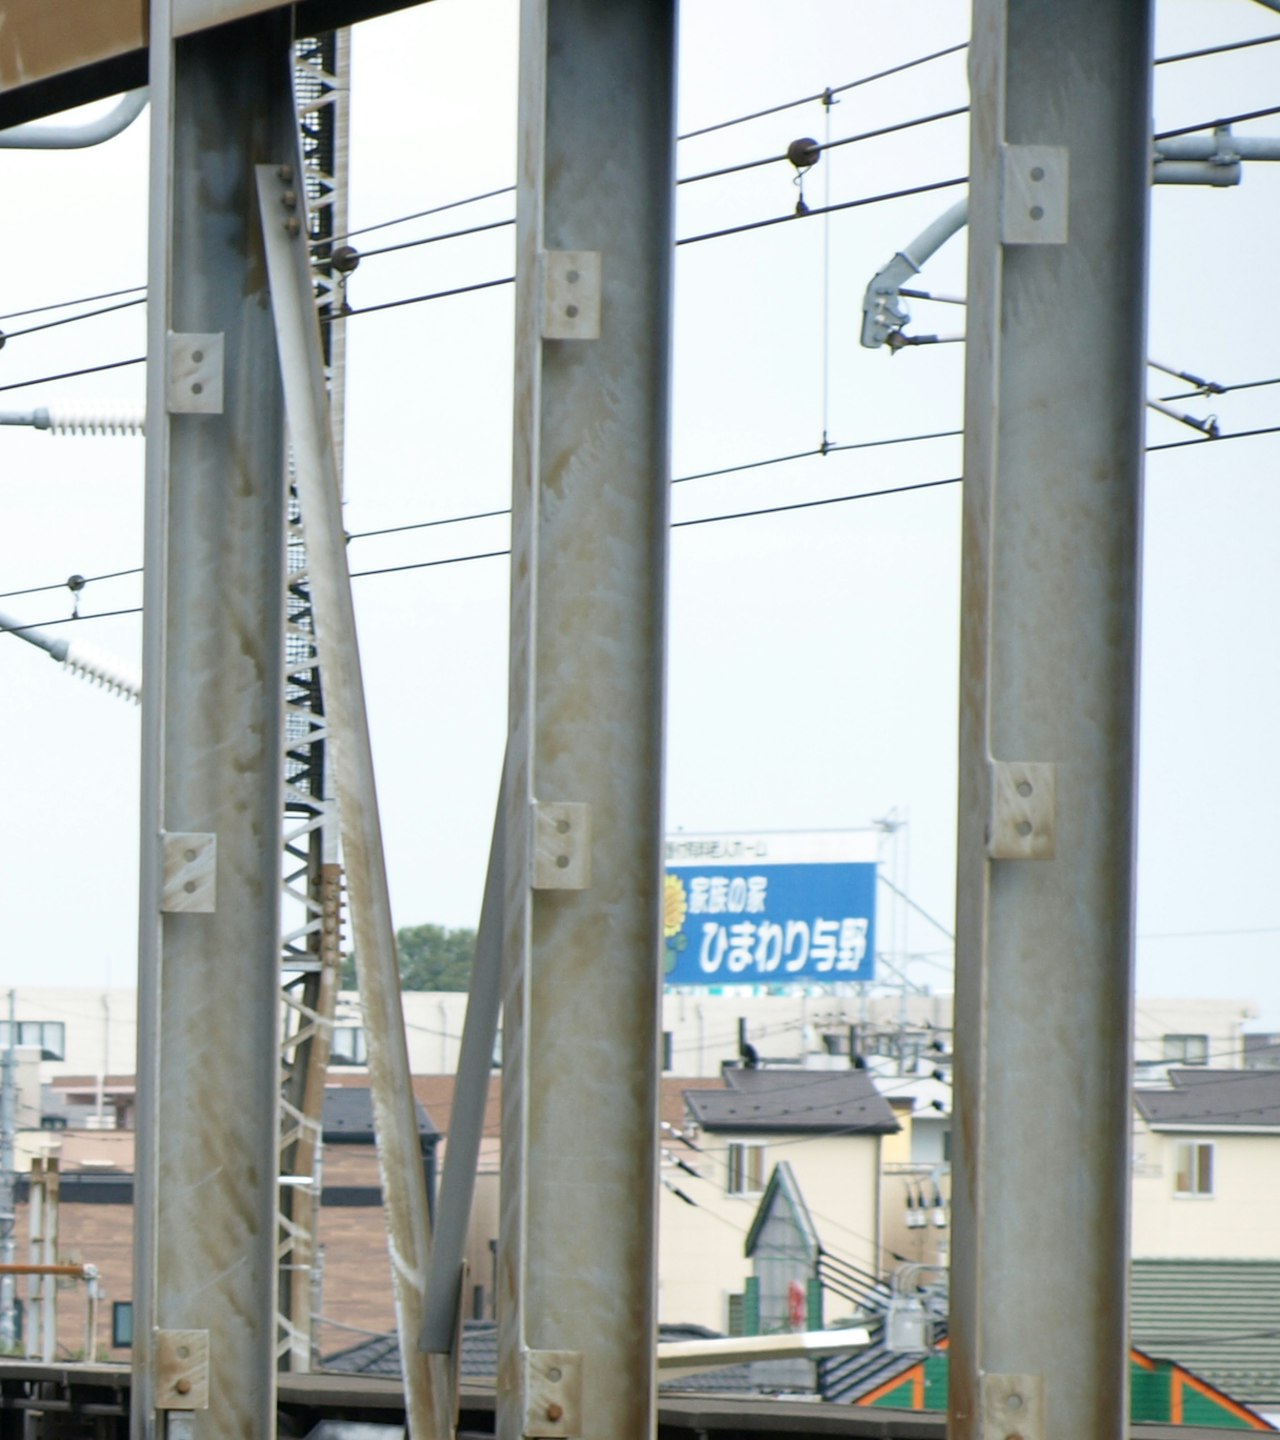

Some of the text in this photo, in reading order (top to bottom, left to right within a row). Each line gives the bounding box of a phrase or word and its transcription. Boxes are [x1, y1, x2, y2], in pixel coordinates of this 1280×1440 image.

[699, 916, 869, 974] ひまわり与野
